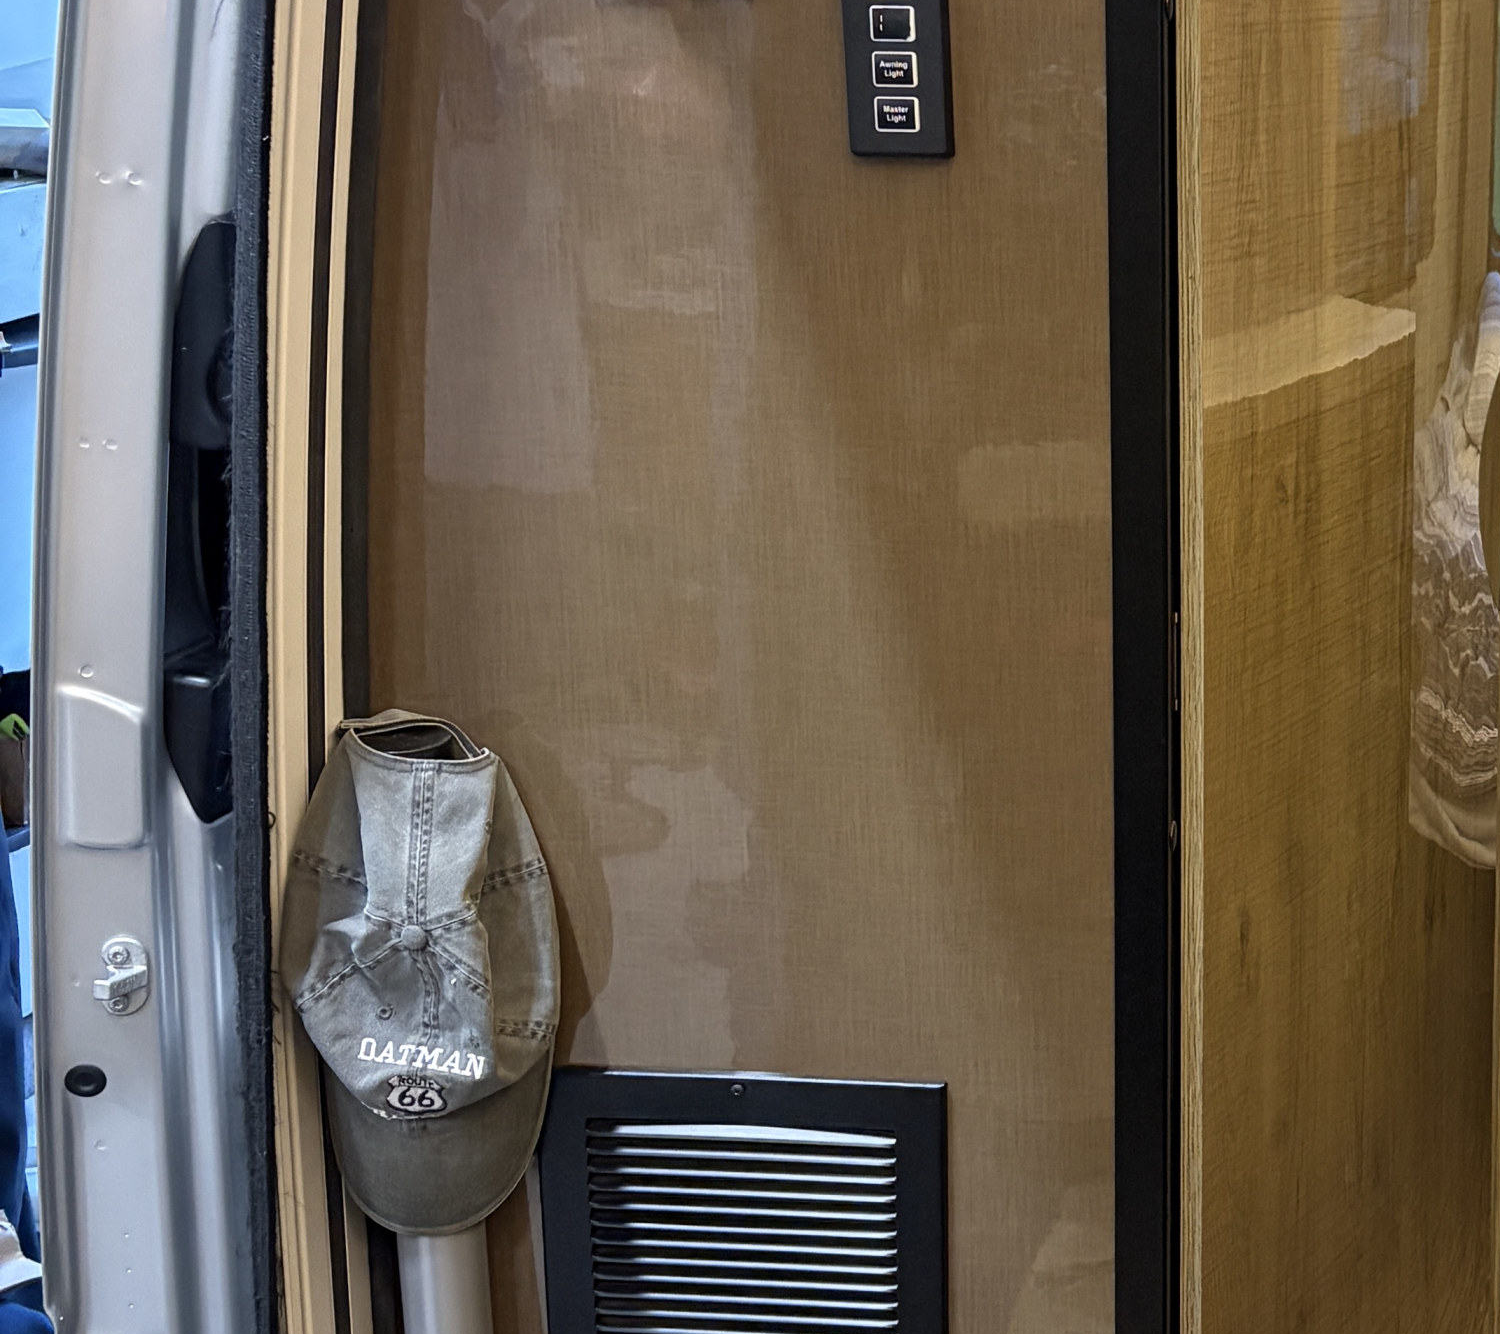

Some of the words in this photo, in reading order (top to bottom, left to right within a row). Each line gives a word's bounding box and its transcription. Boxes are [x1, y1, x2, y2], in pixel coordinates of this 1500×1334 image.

[879, 60, 909, 70] Awning
[884, 69, 905, 79] Light
[883, 105, 909, 114] Master
[886, 114, 906, 124] Light
[357, 1037, 486, 1080] OATMAN
[398, 1087, 435, 1108] 66
